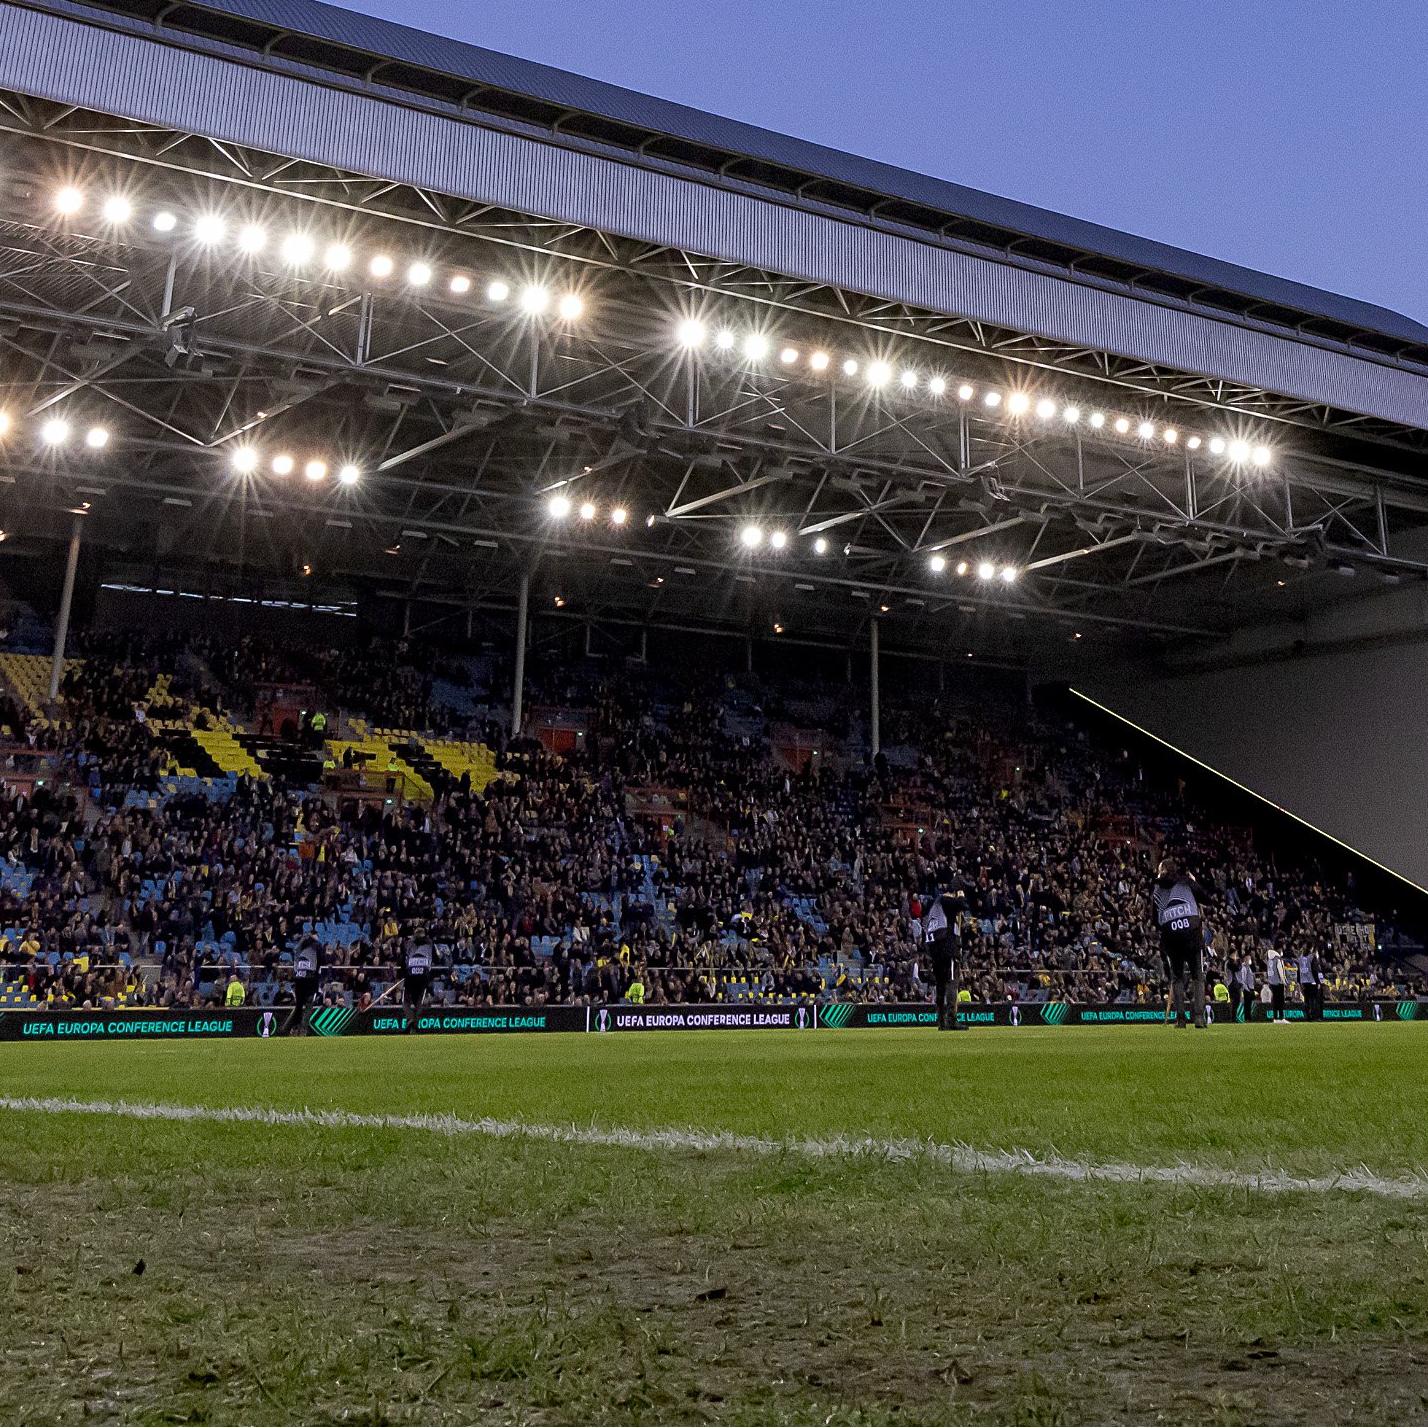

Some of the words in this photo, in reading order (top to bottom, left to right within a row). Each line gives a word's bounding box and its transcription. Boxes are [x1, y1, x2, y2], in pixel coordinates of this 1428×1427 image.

[617, 1015, 644, 1026] UEFA
[646, 1015, 685, 1026] EUROPA
[686, 1014, 751, 1026] CONFERENCE
[753, 1013, 790, 1025] LEAGUE
[867, 1013, 886, 1022] UEFA
[888, 1013, 917, 1022] EUROPA
[967, 1012, 994, 1021] LEAGUE
[1081, 1011, 1098, 1020] UEFA
[1099, 1011, 1123, 1020] EUROPA
[1125, 1011, 1166, 1020] CONFERENCE
[23, 1023, 54, 1035] UEFA
[57, 1022, 105, 1035] EUROPA
[108, 1021, 185, 1034] CONFERENCE
[187, 1020, 233, 1033] LEAGUE
[373, 1018, 399, 1029] UEFA
[443, 1017, 507, 1028] CONFERENCE
[509, 1016, 546, 1027] LEAGUE
